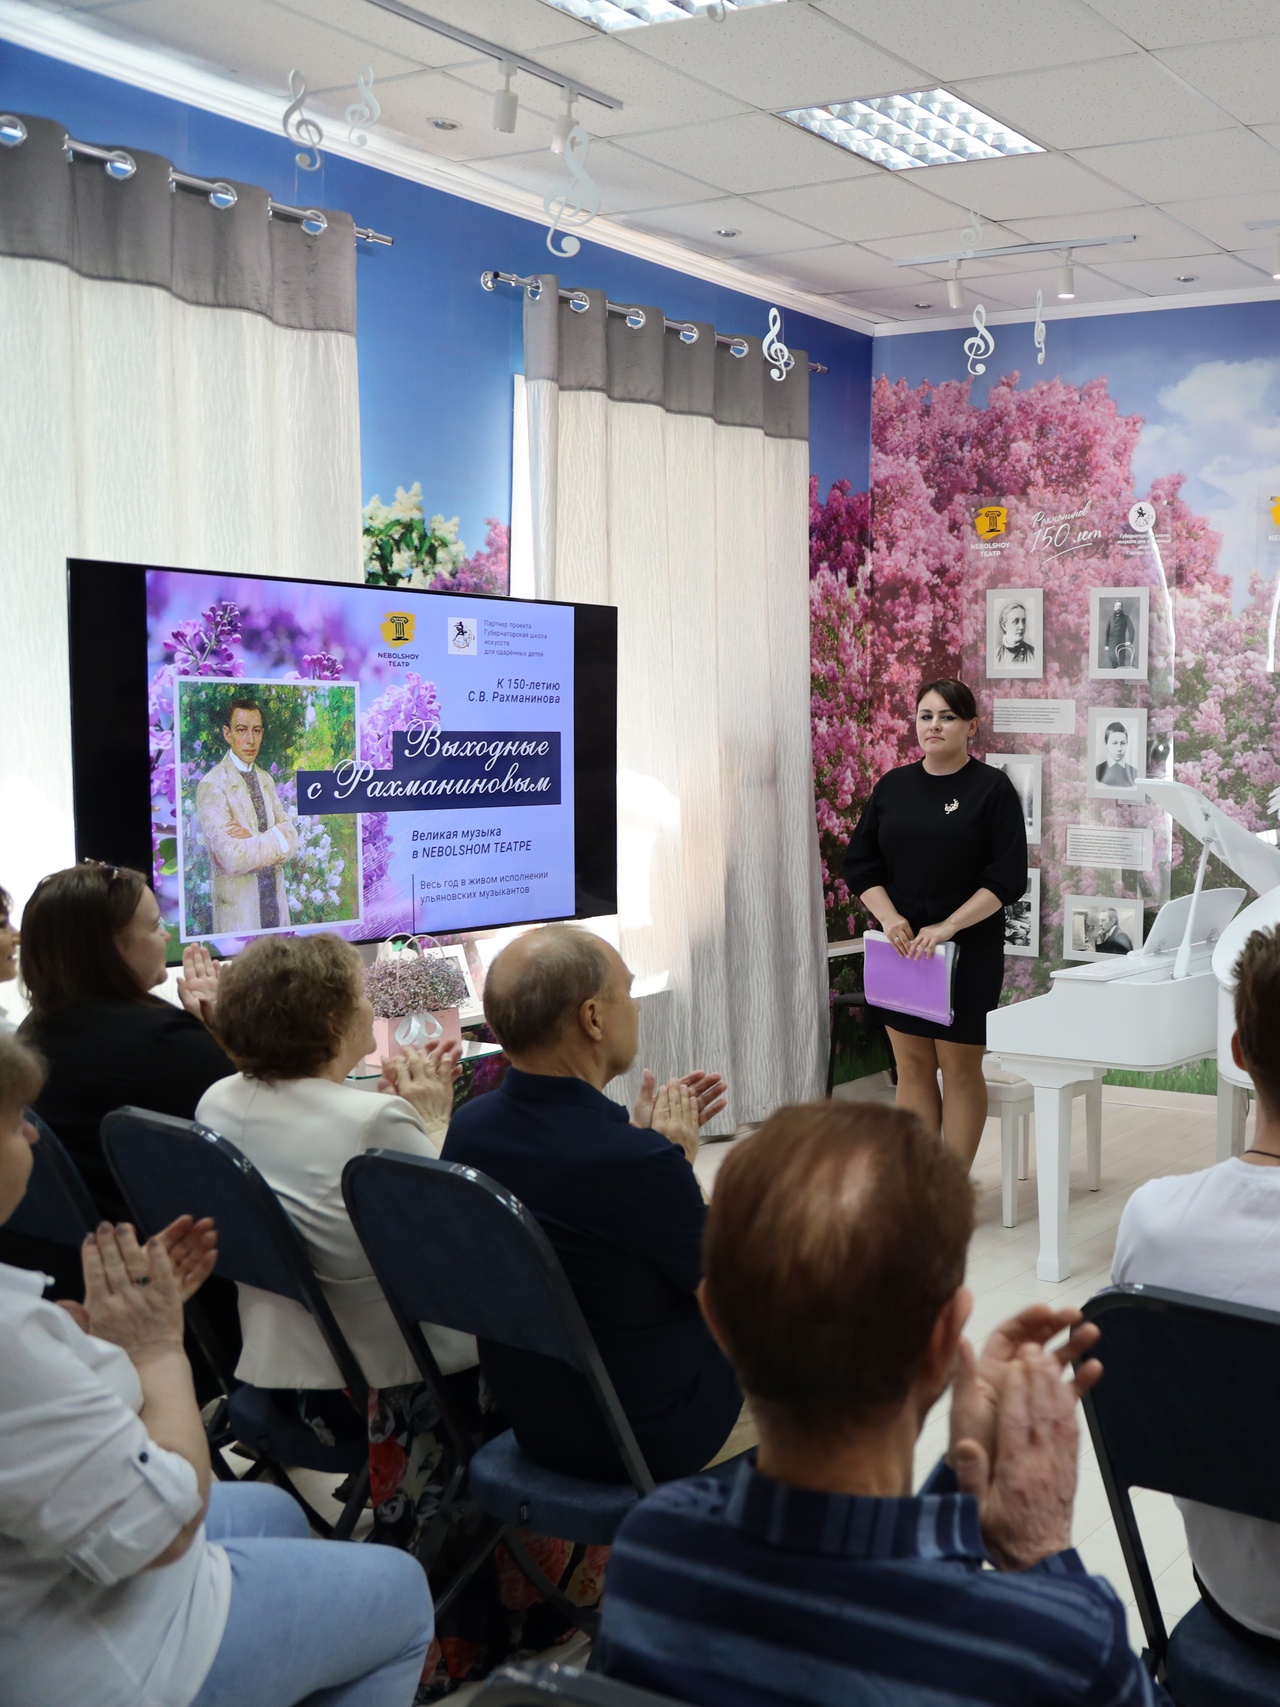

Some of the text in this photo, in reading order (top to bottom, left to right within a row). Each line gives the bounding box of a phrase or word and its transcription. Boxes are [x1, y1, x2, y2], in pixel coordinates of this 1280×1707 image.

[1031, 499, 1092, 528] Рахманинов
[1030, 523, 1102, 553] 150 лет
[970, 541, 1010, 550] NEBOLSHOY
[980, 550, 1001, 558] ТЕАТР
[484, 629, 529, 638] Губернаторская
[377, 652, 420, 660] NEBOLSHOY
[388, 660, 410, 668] ТЕАТР
[497, 678, 560, 691] К 150-летию
[468, 690, 561, 704] С.В. Рахманинова
[403, 718, 550, 771] Выходные
[307, 759, 552, 800] с Рахманиновым
[412, 828, 502, 842] Великая музыка
[412, 840, 532, 859] в NEBOLSHOM ТЕАТРЕ
[420, 880, 442, 890] Весь
[444, 879, 459, 888] год
[468, 877, 498, 886] живом
[499, 871, 549, 883] исполнении
[420, 886, 530, 905] ульяновских музыкантов
